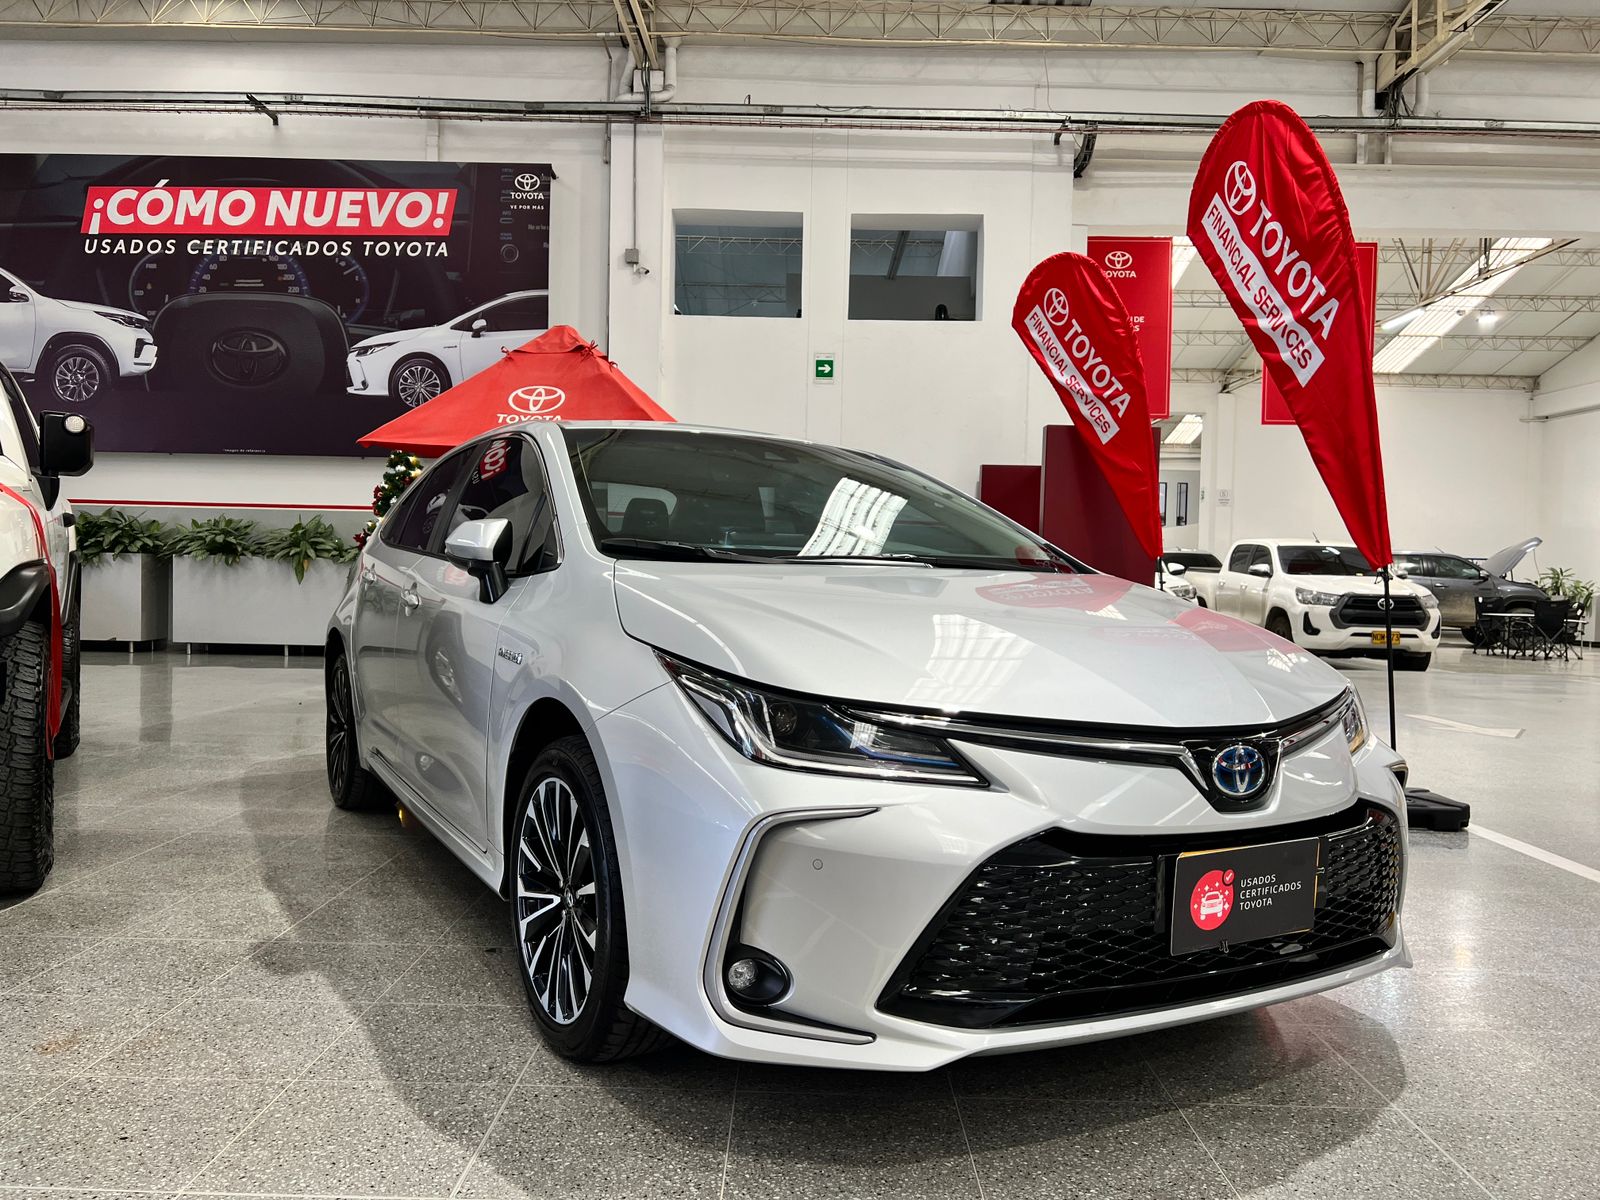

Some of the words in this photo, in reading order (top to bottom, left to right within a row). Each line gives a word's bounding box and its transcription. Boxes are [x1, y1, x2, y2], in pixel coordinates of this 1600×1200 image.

[510, 192, 544, 200] TOYOTA
[88, 179, 256, 235] ¡CÓMO
[264, 190, 449, 229] NUEVO!
[84, 239, 177, 255] USADOS
[187, 239, 353, 257] CERTIFICADOS
[363, 240, 449, 257] TOYOTA
[1249, 199, 1340, 341] TOYOTA
[1207, 204, 1257, 292] FINANCIAL
[1253, 285, 1312, 370] SERVICES
[1133, 315, 1145, 323] DE
[1028, 311, 1069, 377] FINANCIAL
[1065, 374, 1111, 434] SERVICES
[1063, 318, 1131, 419] TOYOTA
[1240, 874, 1276, 887] USADOS
[1240, 881, 1302, 899] CERTIFICADOS
[1240, 898, 1272, 910] TOYOTA
